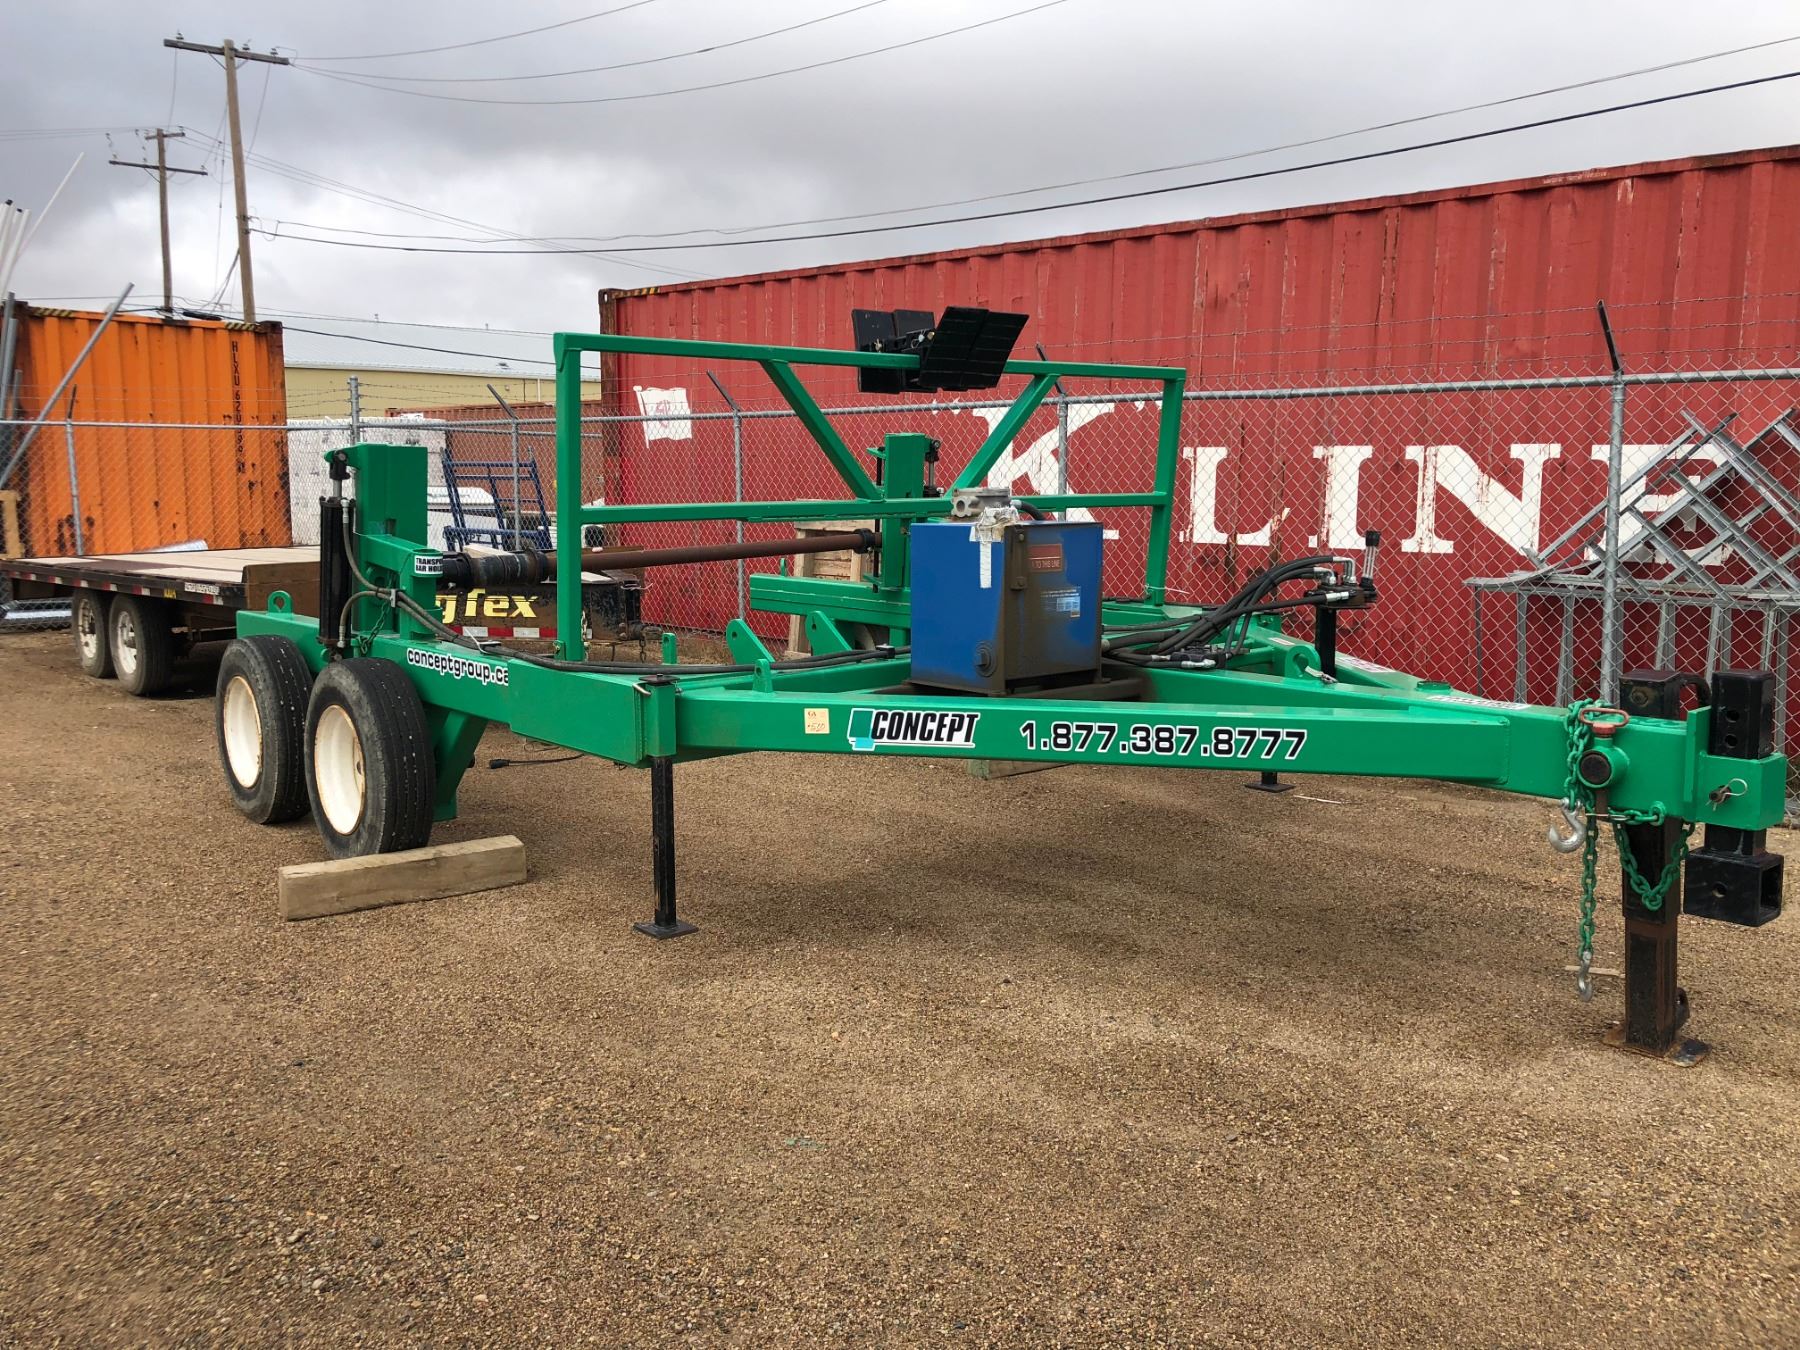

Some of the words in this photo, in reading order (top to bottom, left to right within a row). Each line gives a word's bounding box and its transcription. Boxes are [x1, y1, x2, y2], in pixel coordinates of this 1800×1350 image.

[231, 341, 241, 386] HLXU
[870, 710, 979, 743] CONCEPT
[1020, 720, 1308, 760] 1.877.387.8777
